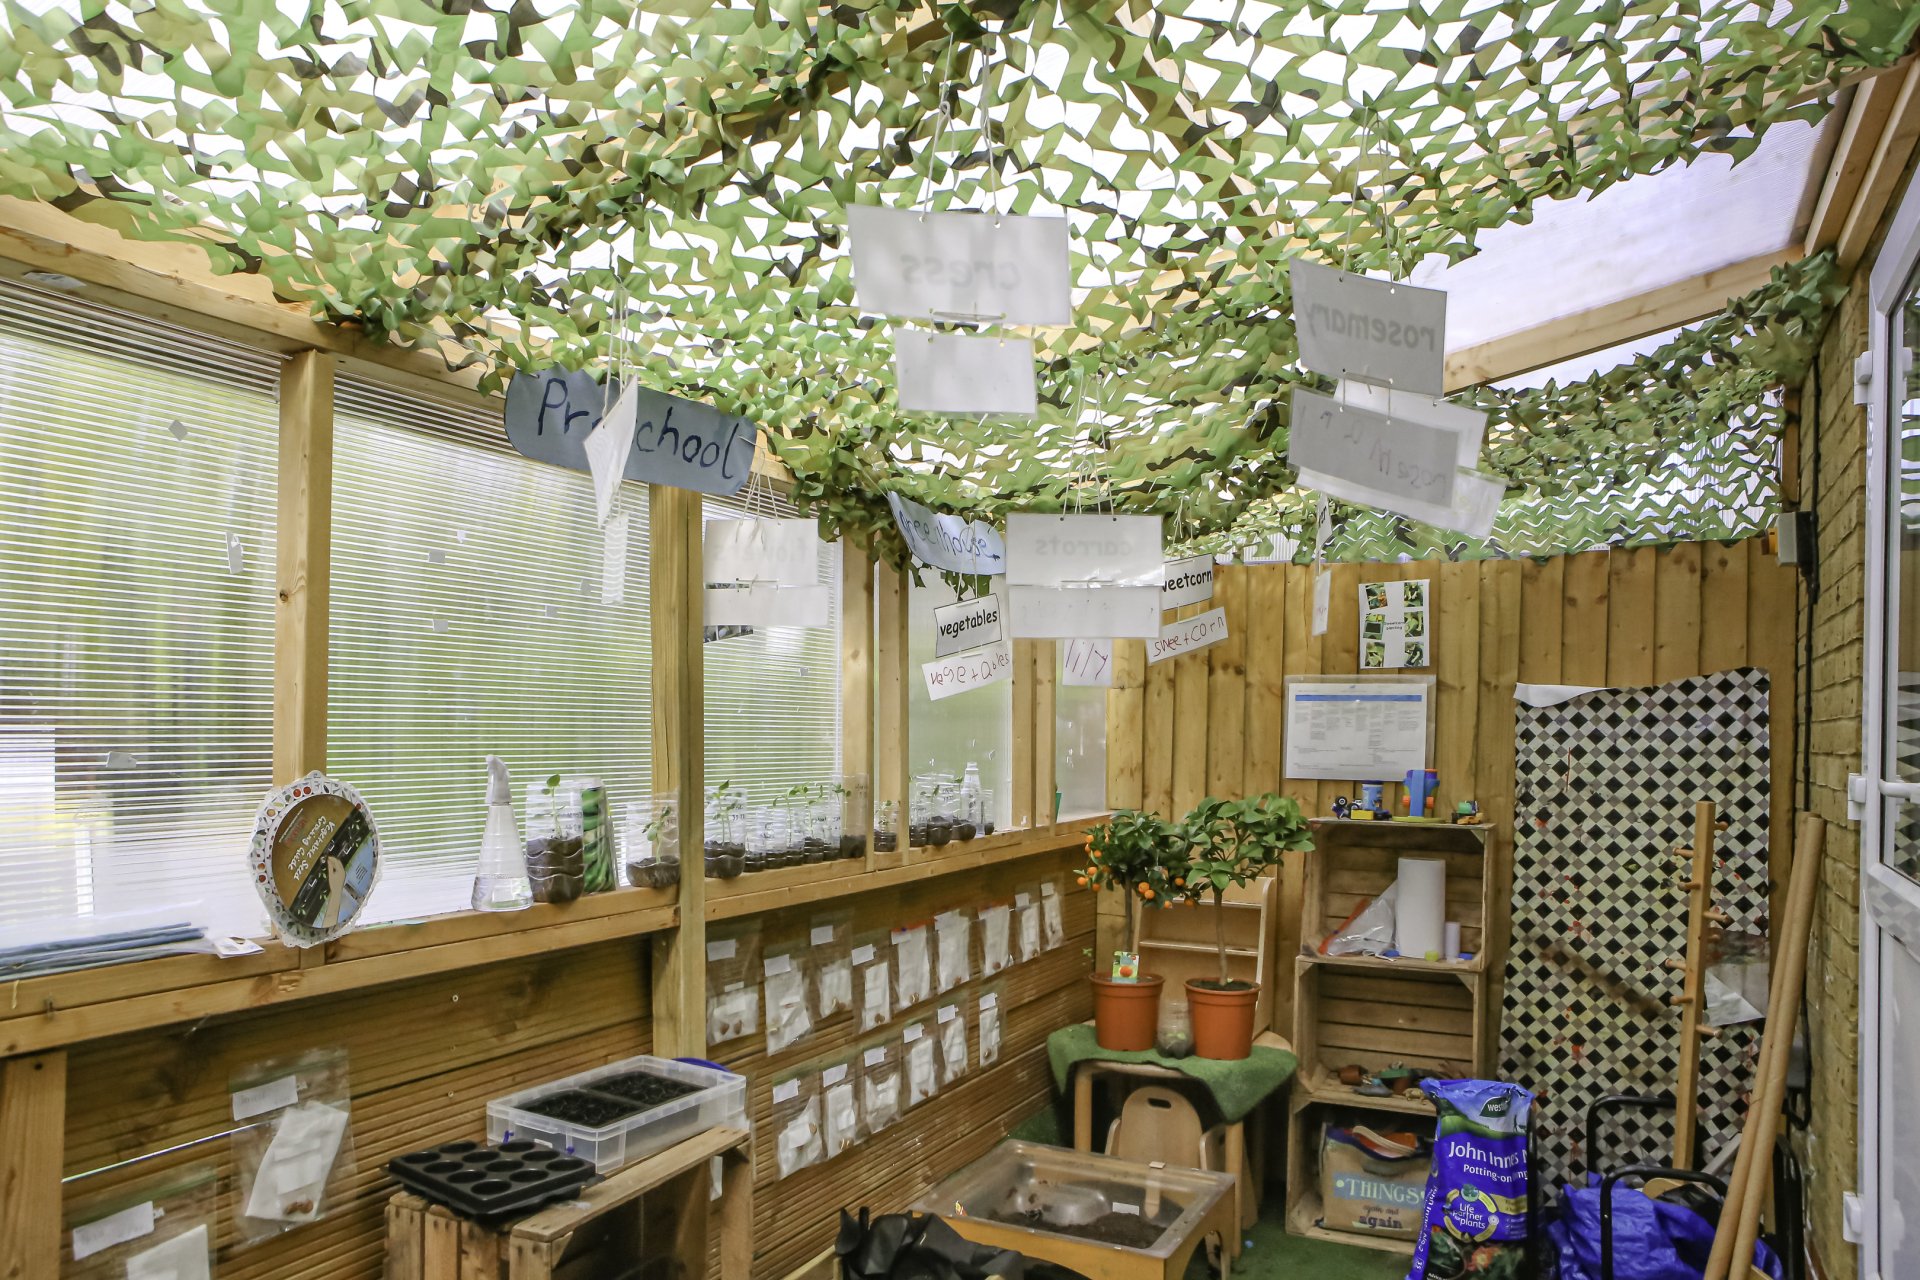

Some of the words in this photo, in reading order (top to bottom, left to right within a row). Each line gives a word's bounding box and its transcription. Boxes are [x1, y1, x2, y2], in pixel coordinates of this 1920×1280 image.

[940, 609, 998, 638] vegetables
[1449, 1141, 1487, 1162] John
[1489, 1151, 1519, 1168] Innes
[1345, 1178, 1419, 1204] THINGS
[1359, 1216, 1403, 1228] again
